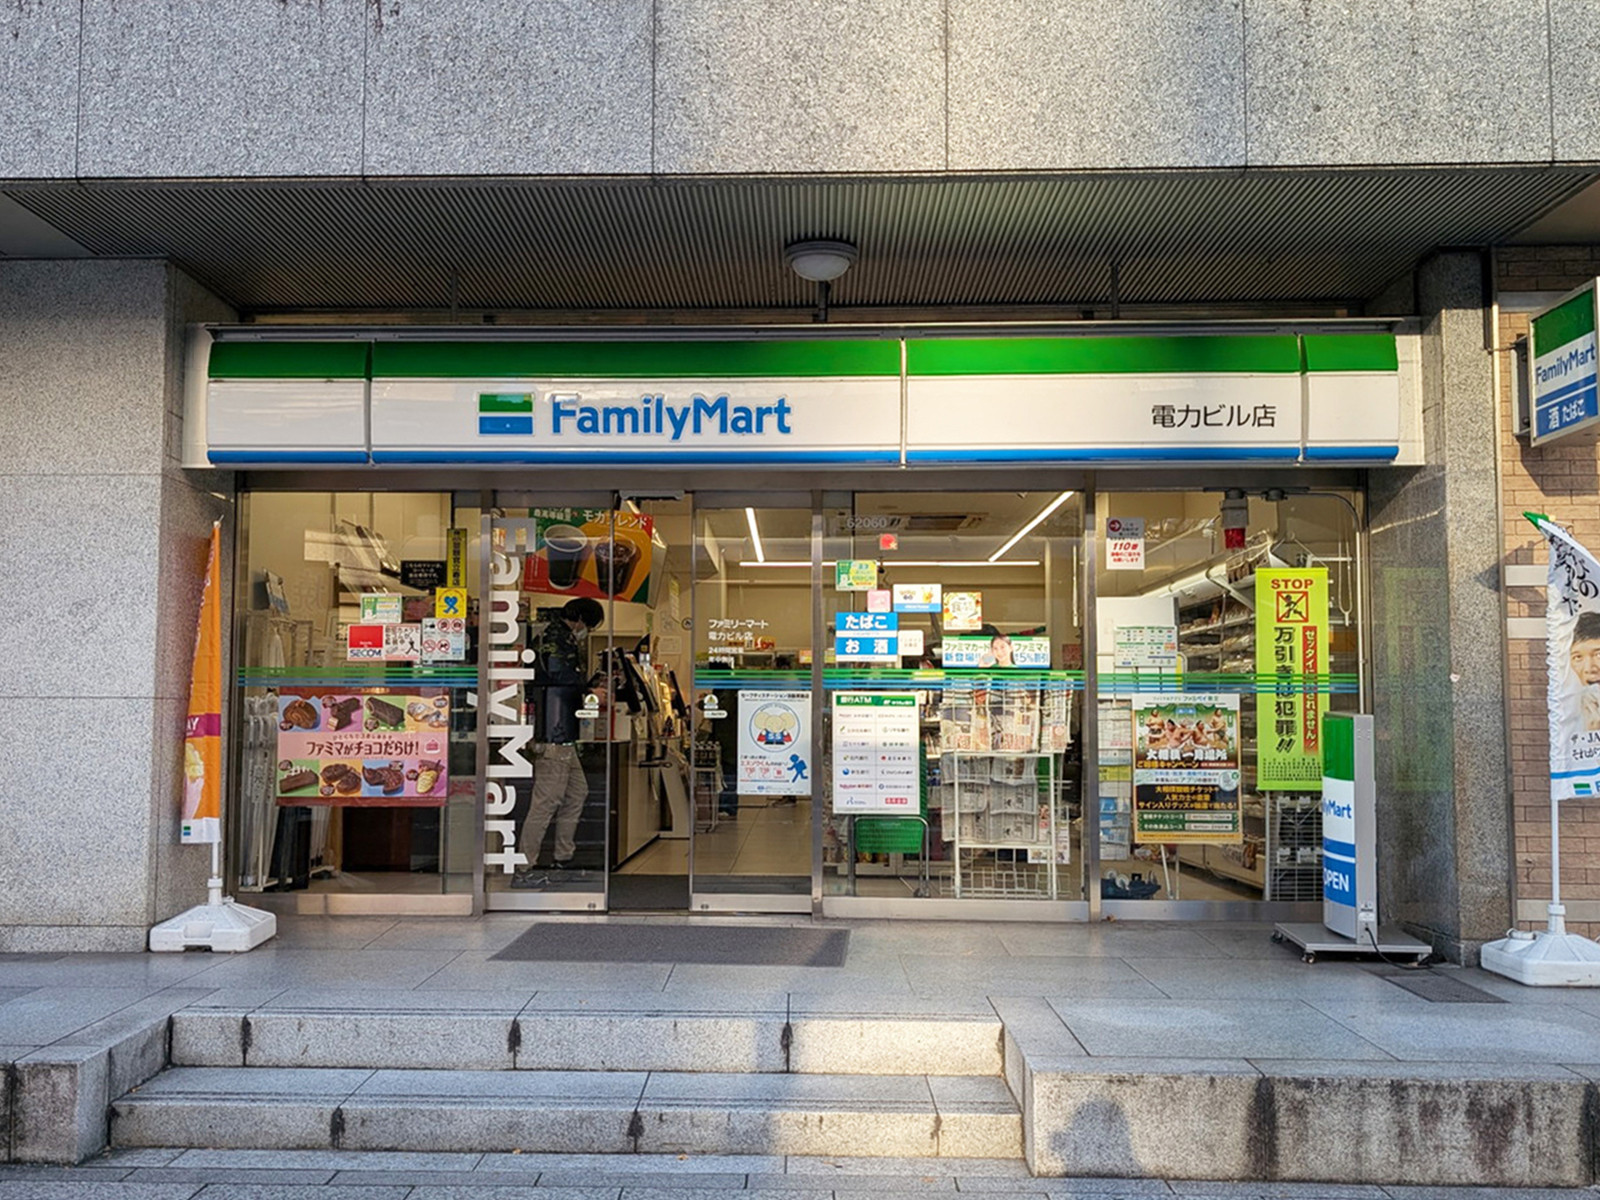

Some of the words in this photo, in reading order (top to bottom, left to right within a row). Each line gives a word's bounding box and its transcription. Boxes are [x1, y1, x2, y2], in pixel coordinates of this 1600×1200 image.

[1535, 344, 1596, 385] FamilyMart
[552, 394, 791, 440] FamilyMart
[1151, 404, 1276, 428] 電力ビル店
[1548, 406, 1560, 429] 酒
[1562, 398, 1585, 423] たばこ
[846, 517, 887, 528] 62060
[1271, 579, 1314, 590] STOP
[708, 619, 769, 629] ファミリーマート
[845, 614, 888, 629] たばこ
[350, 649, 382, 658] SECOM
[485, 517, 537, 874] FamilyMart
[306, 740, 419, 756] ファミマがチョコだらけ!
